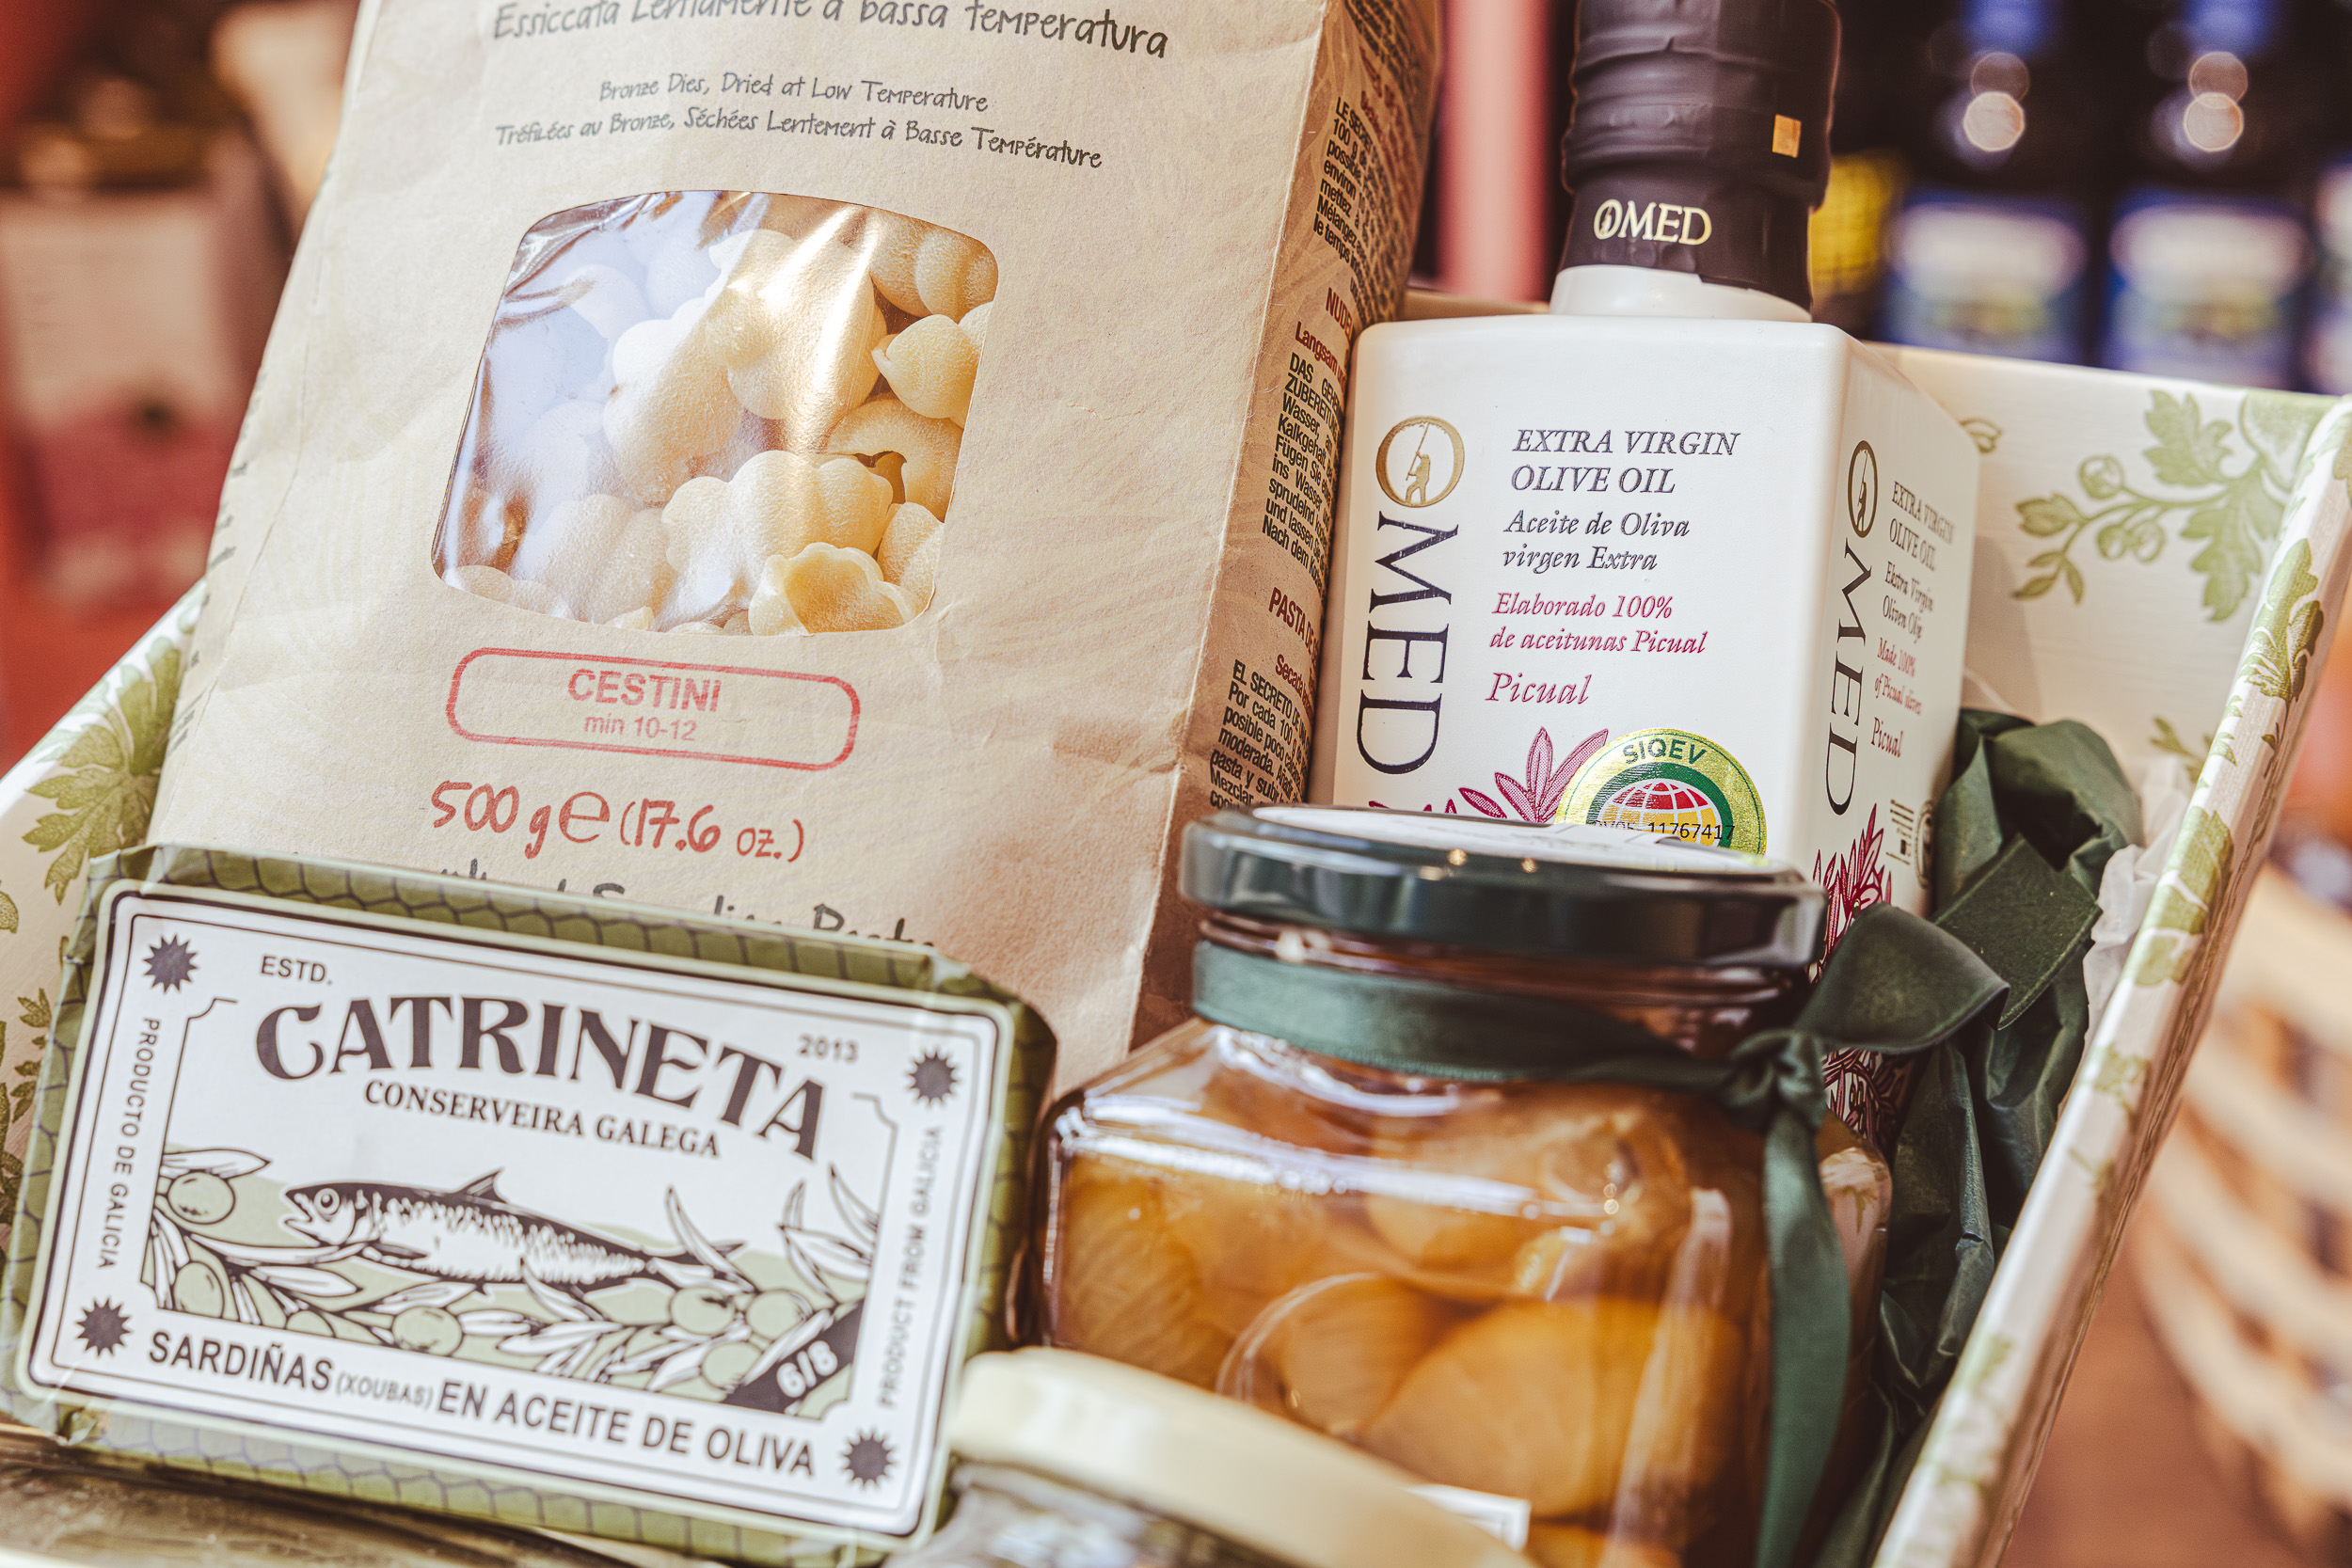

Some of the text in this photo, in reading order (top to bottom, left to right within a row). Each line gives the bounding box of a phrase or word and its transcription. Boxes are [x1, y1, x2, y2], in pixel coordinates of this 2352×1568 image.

[494, 1, 618, 39] Essiccata
[860, 0, 948, 28] bassa
[964, 0, 1168, 58] temperatura
[599, 71, 989, 112] Bronze Dies, Dried at Low Temperature
[495, 122, 576, 146] Tréfilées
[611, 112, 675, 135] Bronze,
[684, 106, 758, 131] Séchées
[767, 110, 876, 138] Lentement
[881, 119, 898, 140] à
[905, 119, 963, 147] Basse
[970, 126, 1104, 169] Température
[1333, 118, 1351, 147] 100
[1593, 198, 1713, 246] OMED
[1289, 352, 1314, 384] DAS
[1295, 321, 1338, 376] Langsam
[1282, 391, 1320, 440] Wasser,
[1275, 433, 1309, 472] Fügen
[1511, 428, 1741, 456] EXTRA VIRGIN
[1272, 452, 1290, 480] ins
[1510, 465, 1677, 495] OLIVE OIL
[1268, 478, 1316, 527] sprudelnd
[1503, 509, 1691, 538] Aceite de Oliva
[1891, 480, 1922, 522] EXTRA
[1262, 514, 1290, 551] Nach
[1291, 539, 1310, 570] dem
[1265, 498, 1288, 524] und
[1288, 511, 1314, 551] lassen
[1889, 517, 1919, 559] OLIVE
[1502, 543, 1659, 575] virgen Extra
[1268, 586, 1306, 641] PASTA
[1356, 415, 1466, 776] OMED
[1492, 592, 1674, 620] Elaborado 100%
[1489, 626, 1708, 656] de aceitunas Picual
[567, 667, 723, 713] CESTINI
[1232, 658, 1248, 686] EL
[1249, 671, 1293, 719] SECRETO
[1486, 672, 1593, 705] Picual
[583, 712, 698, 742] min 10-12
[1223, 705, 1285, 762] posible poco
[1228, 680, 1249, 708] Por
[1252, 700, 1276, 730] cada
[1280, 719, 1293, 745] 100
[1218, 727, 1275, 777] moderada.
[1621, 737, 1709, 766] SIQEV
[1870, 717, 1904, 758] Picual
[1210, 749, 1243, 781] pasta
[1245, 770, 1255, 790] y
[430, 780, 520, 833] 500
[619, 798, 722, 853] (17.6
[736, 819, 804, 863] oz.)
[1648, 821, 1735, 841] 11767417
[259, 955, 333, 986] ESTD.
[796, 1034, 858, 1063] 2013
[254, 994, 825, 1163] CATRINETA
[364, 1078, 721, 1159] CONSERVEIRA GALEGA
[97, 1017, 161, 1269] PRODUCTO DE GALICIA
[877, 1296, 914, 1410] PRODUCT
[898, 1225, 927, 1292] FROM
[775, 1338, 839, 1399] 6/8
[149, 1330, 816, 1477] SARDIÑAS (XOUBAS) EN ACEITE DE OLIVA
